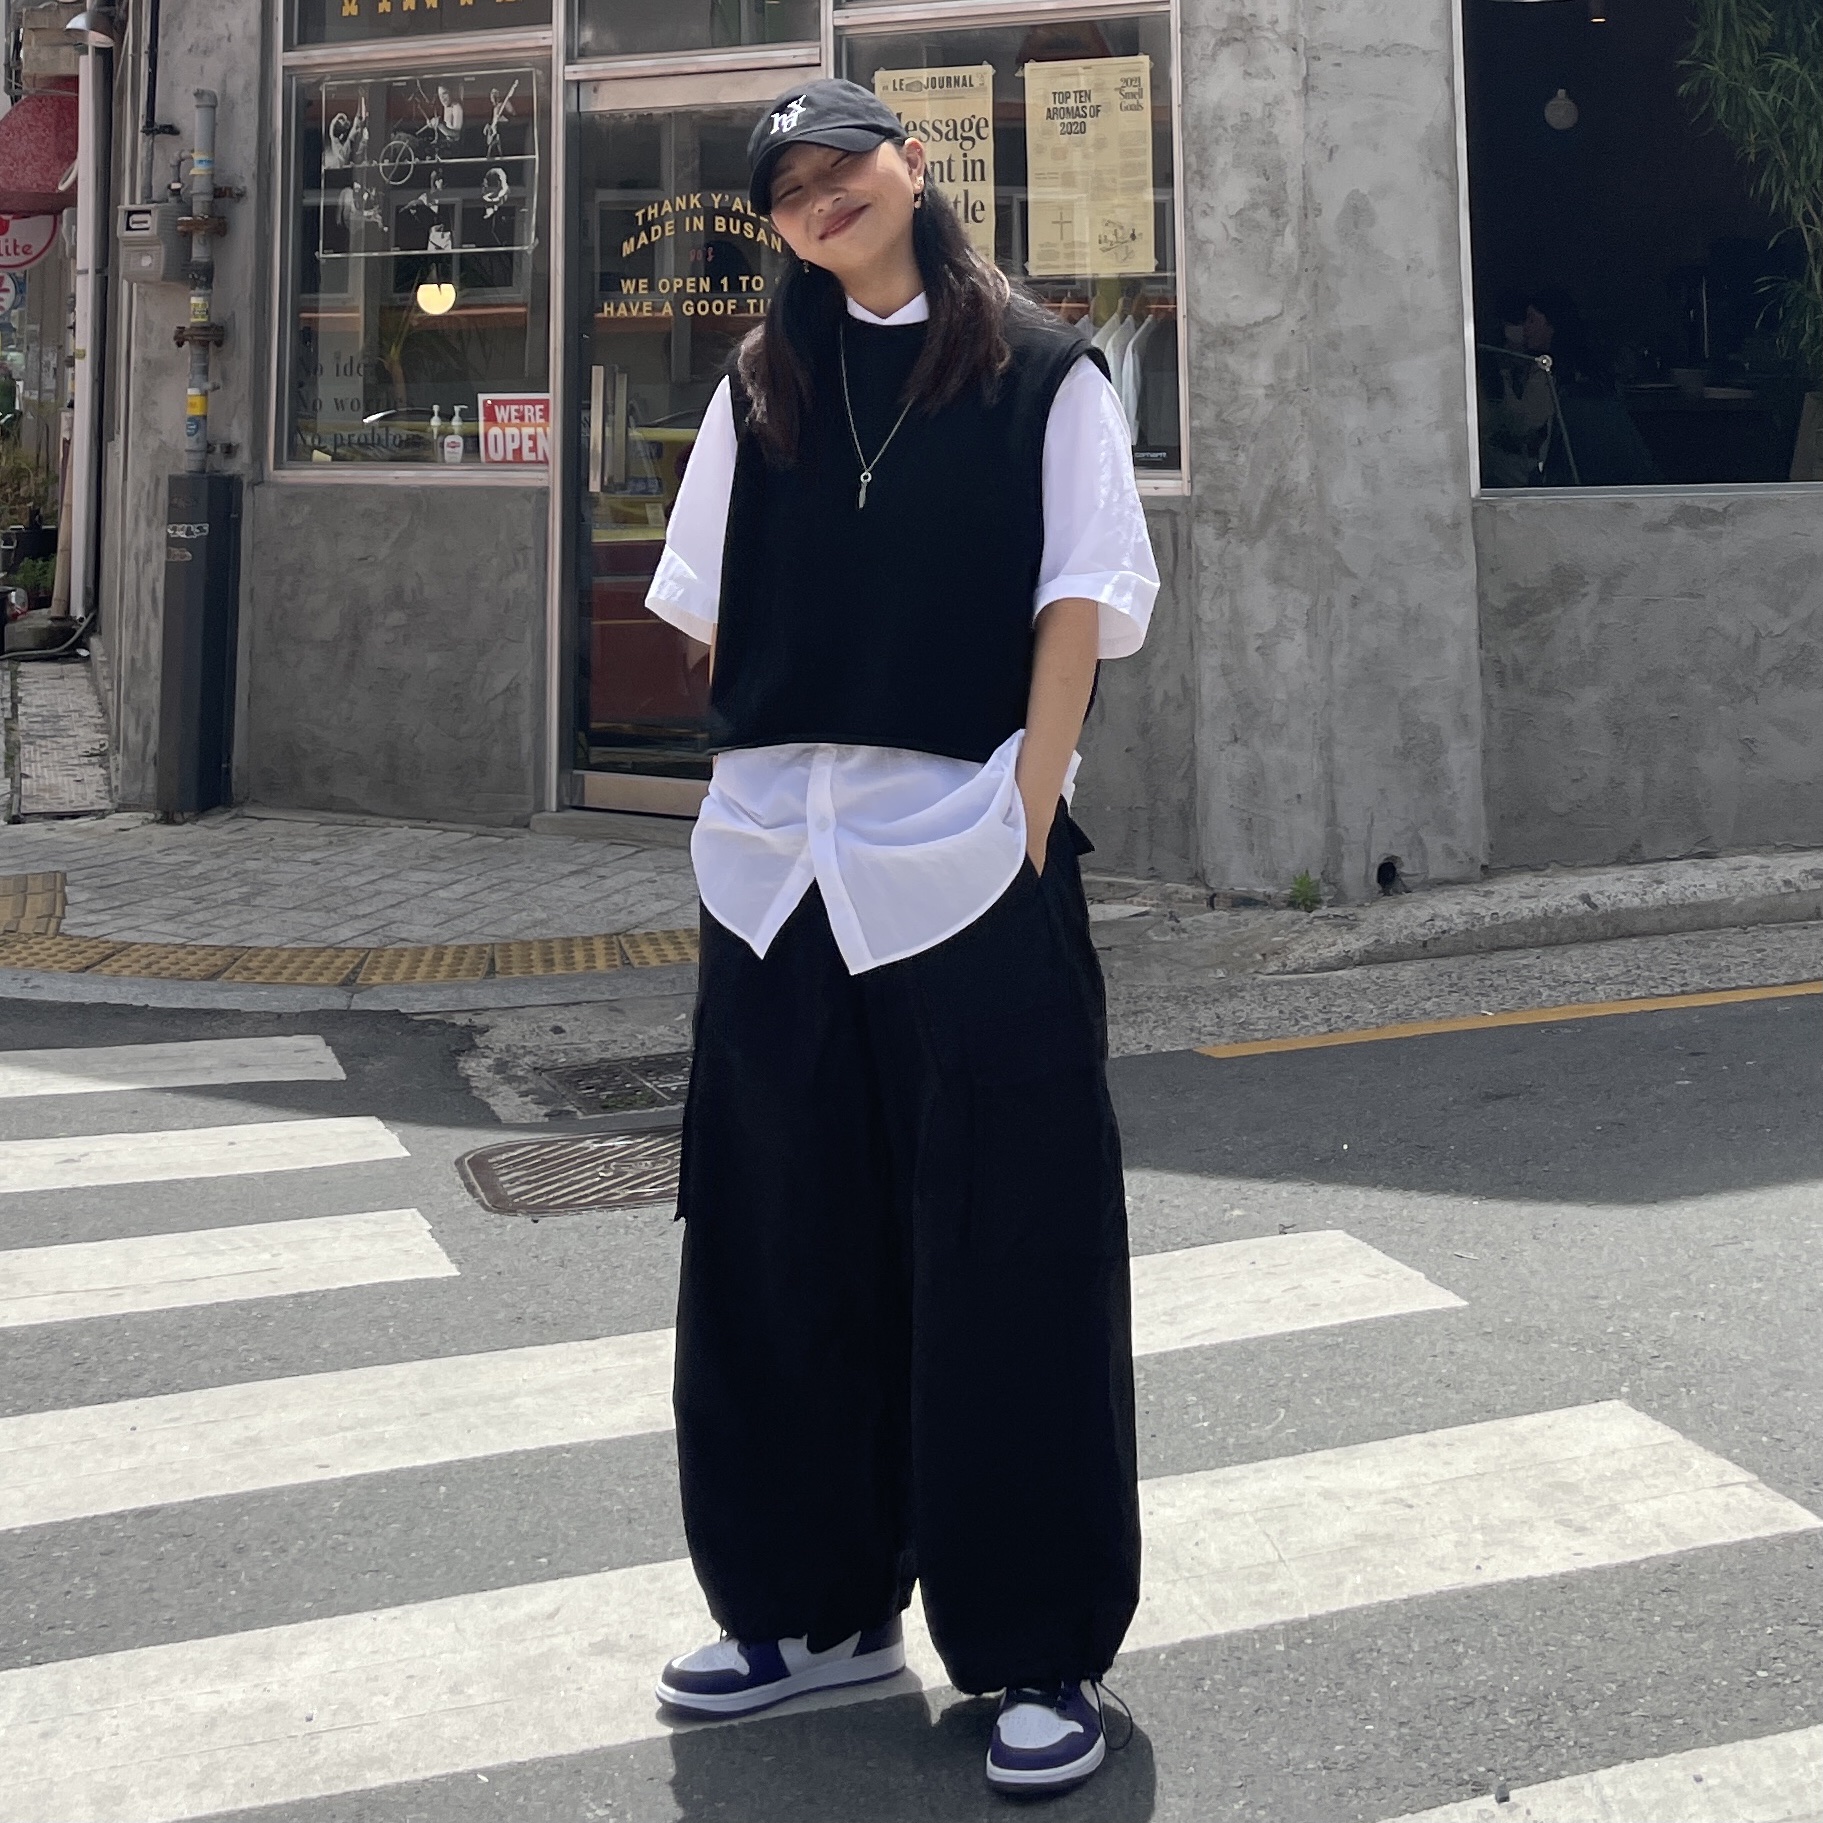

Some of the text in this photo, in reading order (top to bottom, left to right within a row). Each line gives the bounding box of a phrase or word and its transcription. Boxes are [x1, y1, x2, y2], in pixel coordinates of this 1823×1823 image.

[892, 78, 904, 92] LE
[923, 74, 974, 90] JOURNAL
[1052, 89, 1092, 105] TOP TEN
[1046, 104, 1102, 120] AROMAS OF
[896, 111, 990, 152] essage
[1059, 120, 1087, 136] 2020
[929, 152, 986, 184] nt in
[635, 192, 769, 227] THANK Y'AL
[952, 188, 986, 224] tle
[621, 219, 675, 258] MADE
[685, 215, 704, 233] IN
[714, 216, 782, 253] BUSAN
[620, 278, 649, 295] WE
[658, 276, 711, 293] OPEN
[720, 276, 729, 292] 1
[738, 275, 764, 291] TO
[603, 298, 771, 317] HAVE A GOOF TI
[494, 404, 545, 424] WE'RE
[487, 426, 550, 462] OPEN
